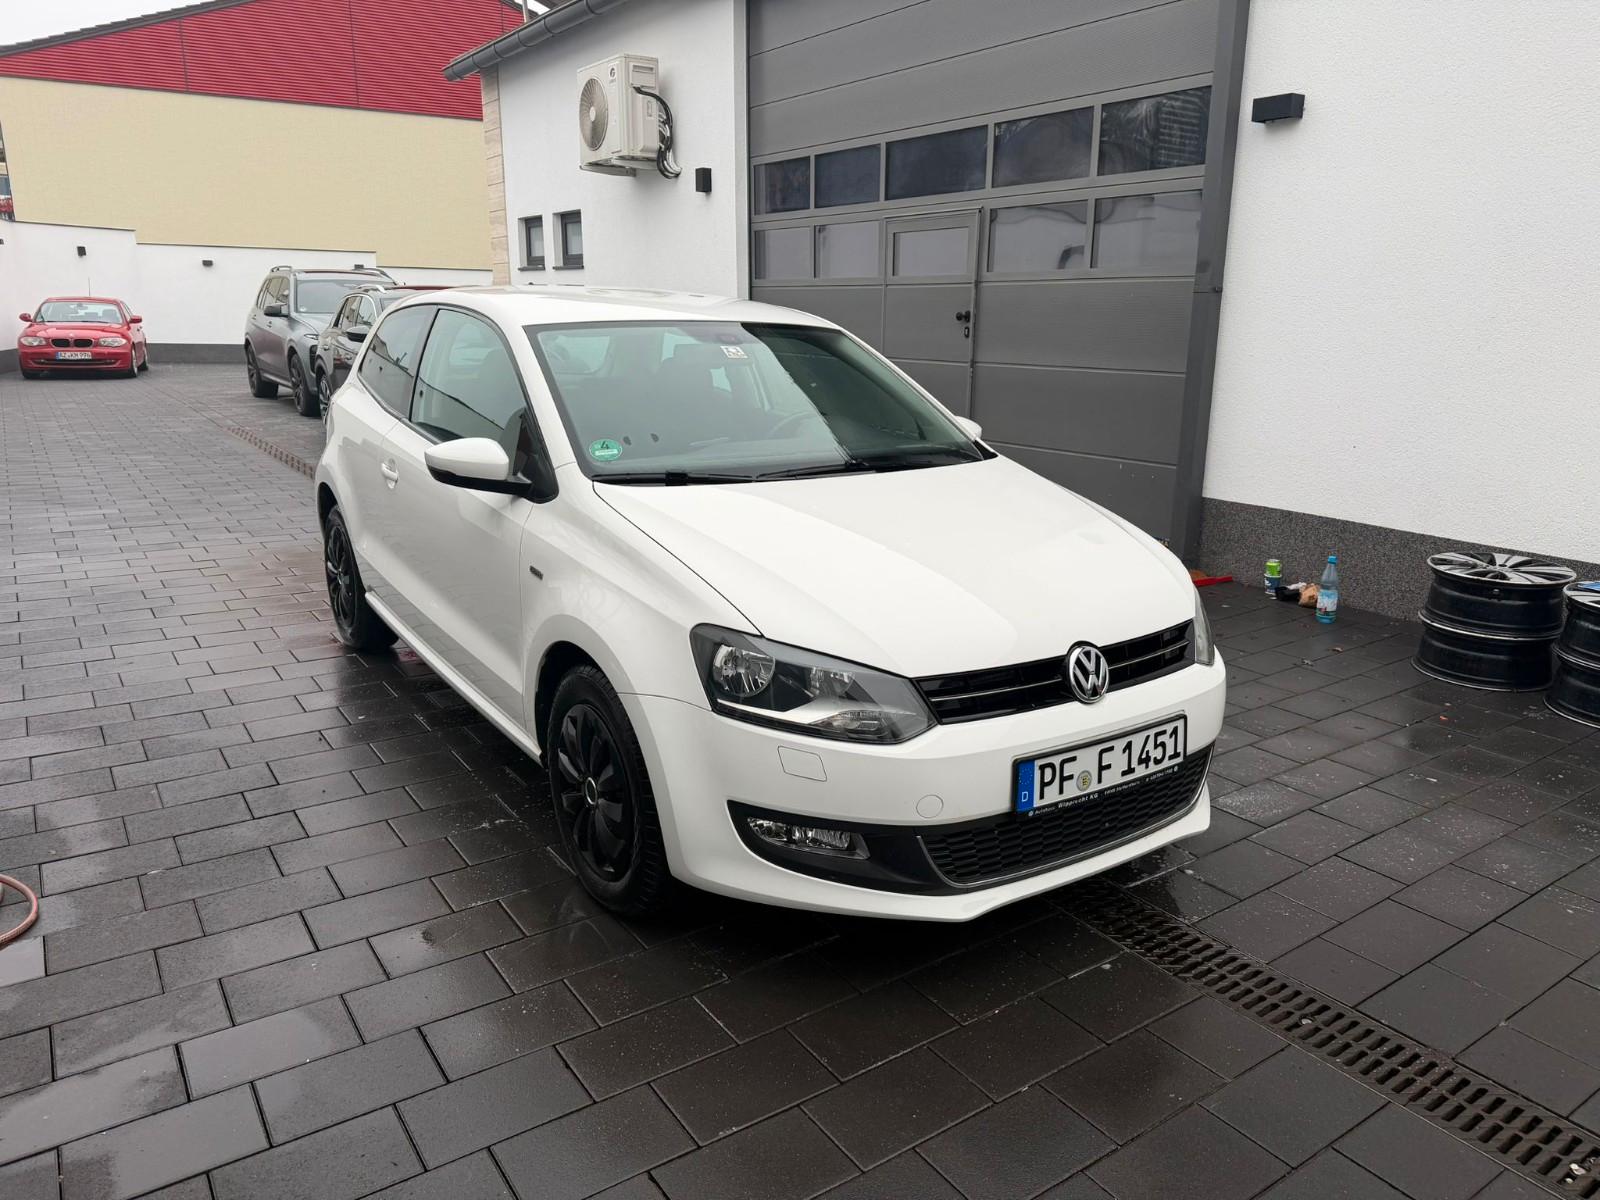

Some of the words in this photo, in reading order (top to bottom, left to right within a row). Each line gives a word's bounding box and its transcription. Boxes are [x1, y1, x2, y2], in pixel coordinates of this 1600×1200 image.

[600, 440, 610, 450] 4
[1070, 645, 1109, 702] VW
[1038, 756, 1077, 800] PF
[1097, 745, 1115, 785] F
[1120, 725, 1182, 777] 1451
[1021, 791, 1029, 802] D
